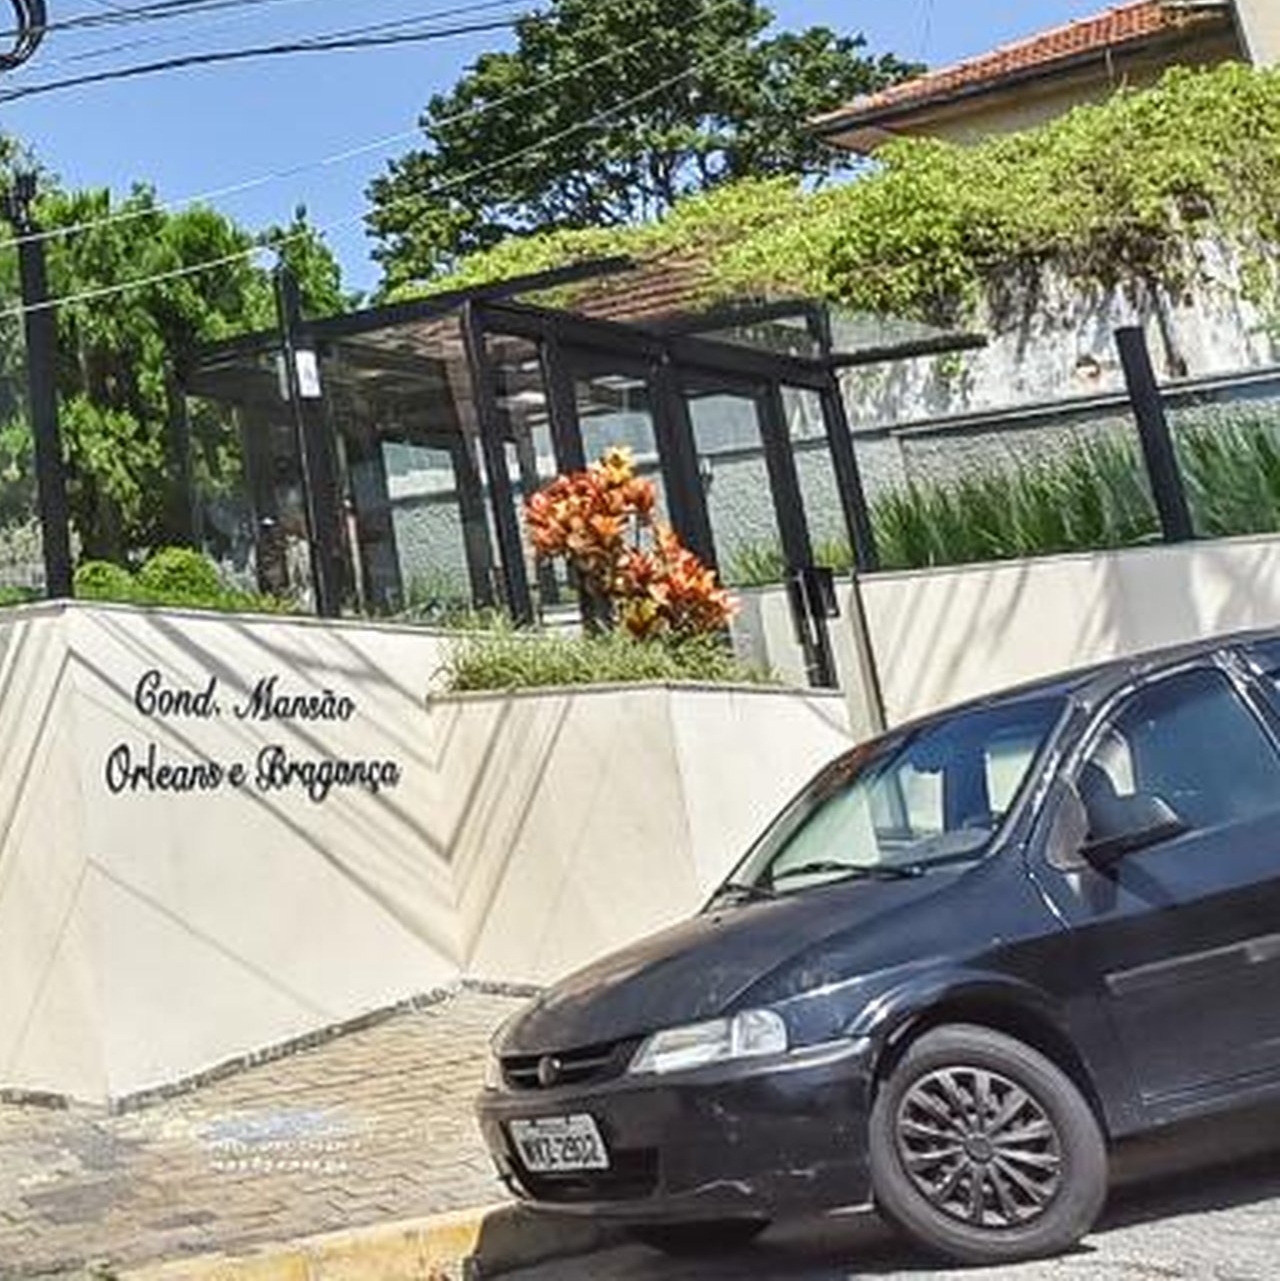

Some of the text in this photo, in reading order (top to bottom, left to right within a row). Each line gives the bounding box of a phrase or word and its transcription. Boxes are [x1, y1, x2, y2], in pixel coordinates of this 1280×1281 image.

[134, 669, 355, 720] Cond. Mansão
[104, 743, 400, 803] Orleans e Bragança
